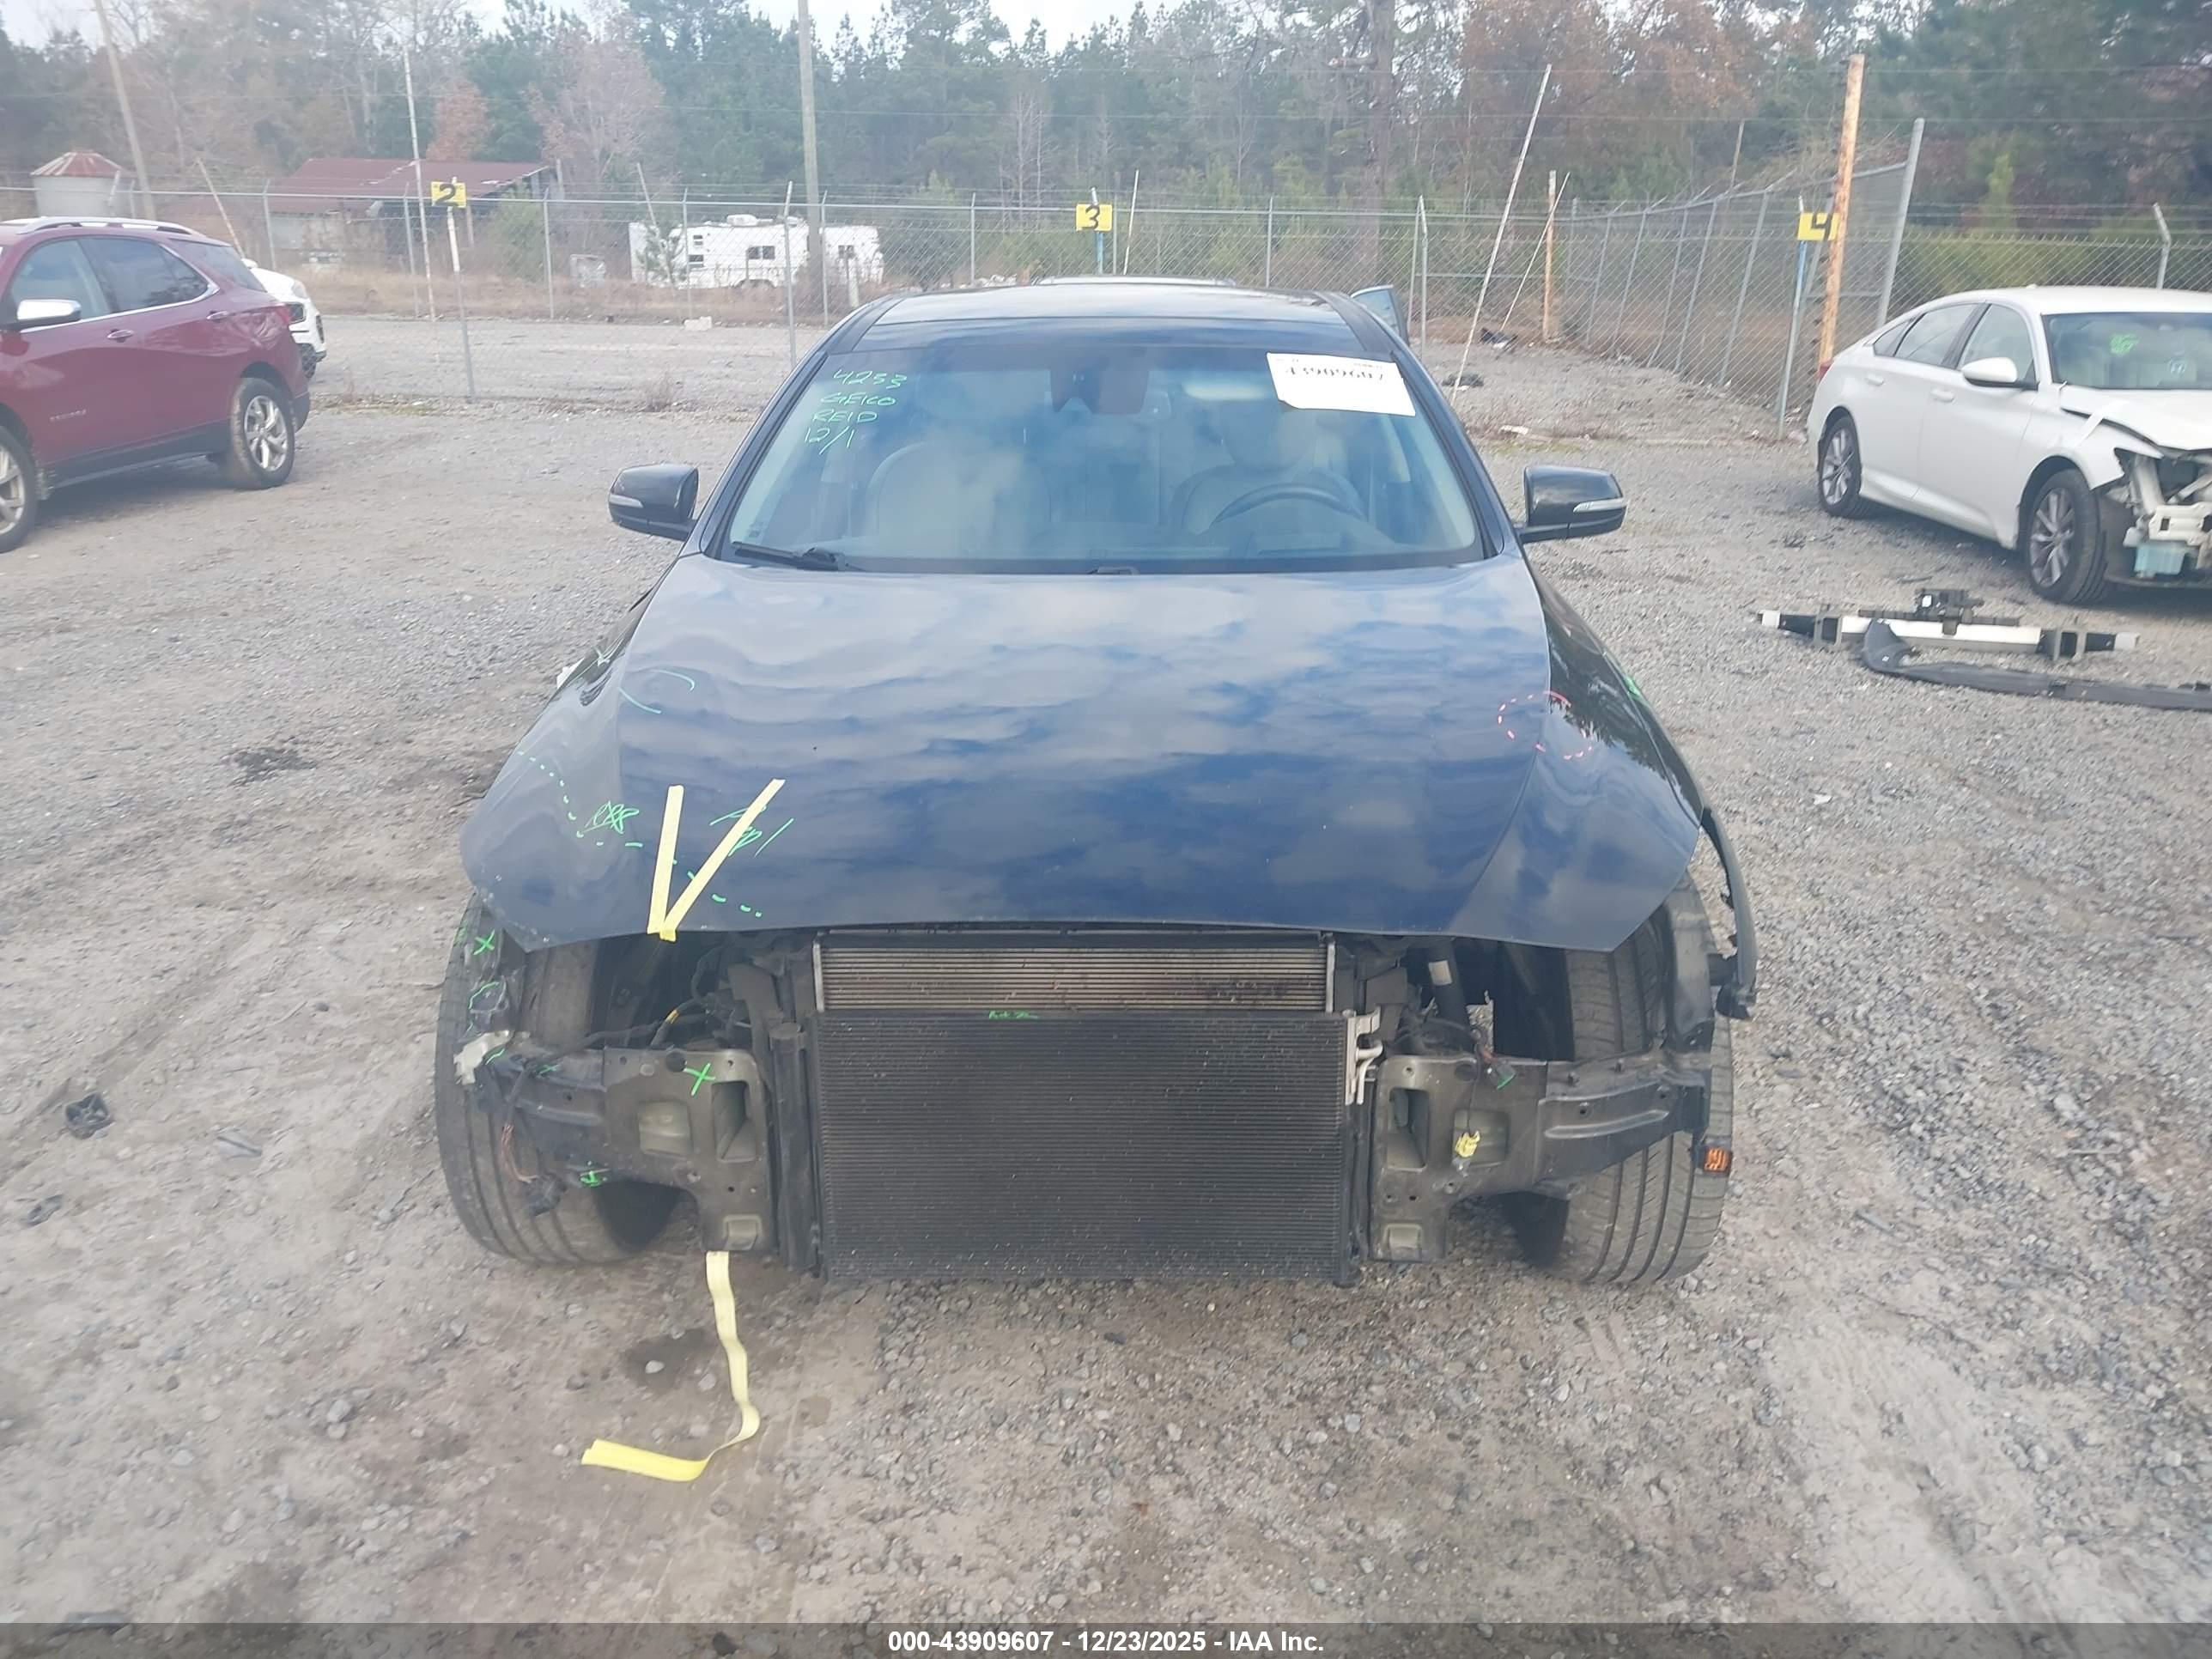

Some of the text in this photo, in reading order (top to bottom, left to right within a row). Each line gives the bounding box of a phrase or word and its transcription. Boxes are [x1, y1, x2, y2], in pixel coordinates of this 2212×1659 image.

[434, 183, 459, 207] 2
[1082, 204, 1100, 230] 3
[1811, 212, 1833, 241] 4
[820, 392, 896, 406] GEICO
[812, 409, 878, 423] REID
[804, 426, 855, 455] 12/1
